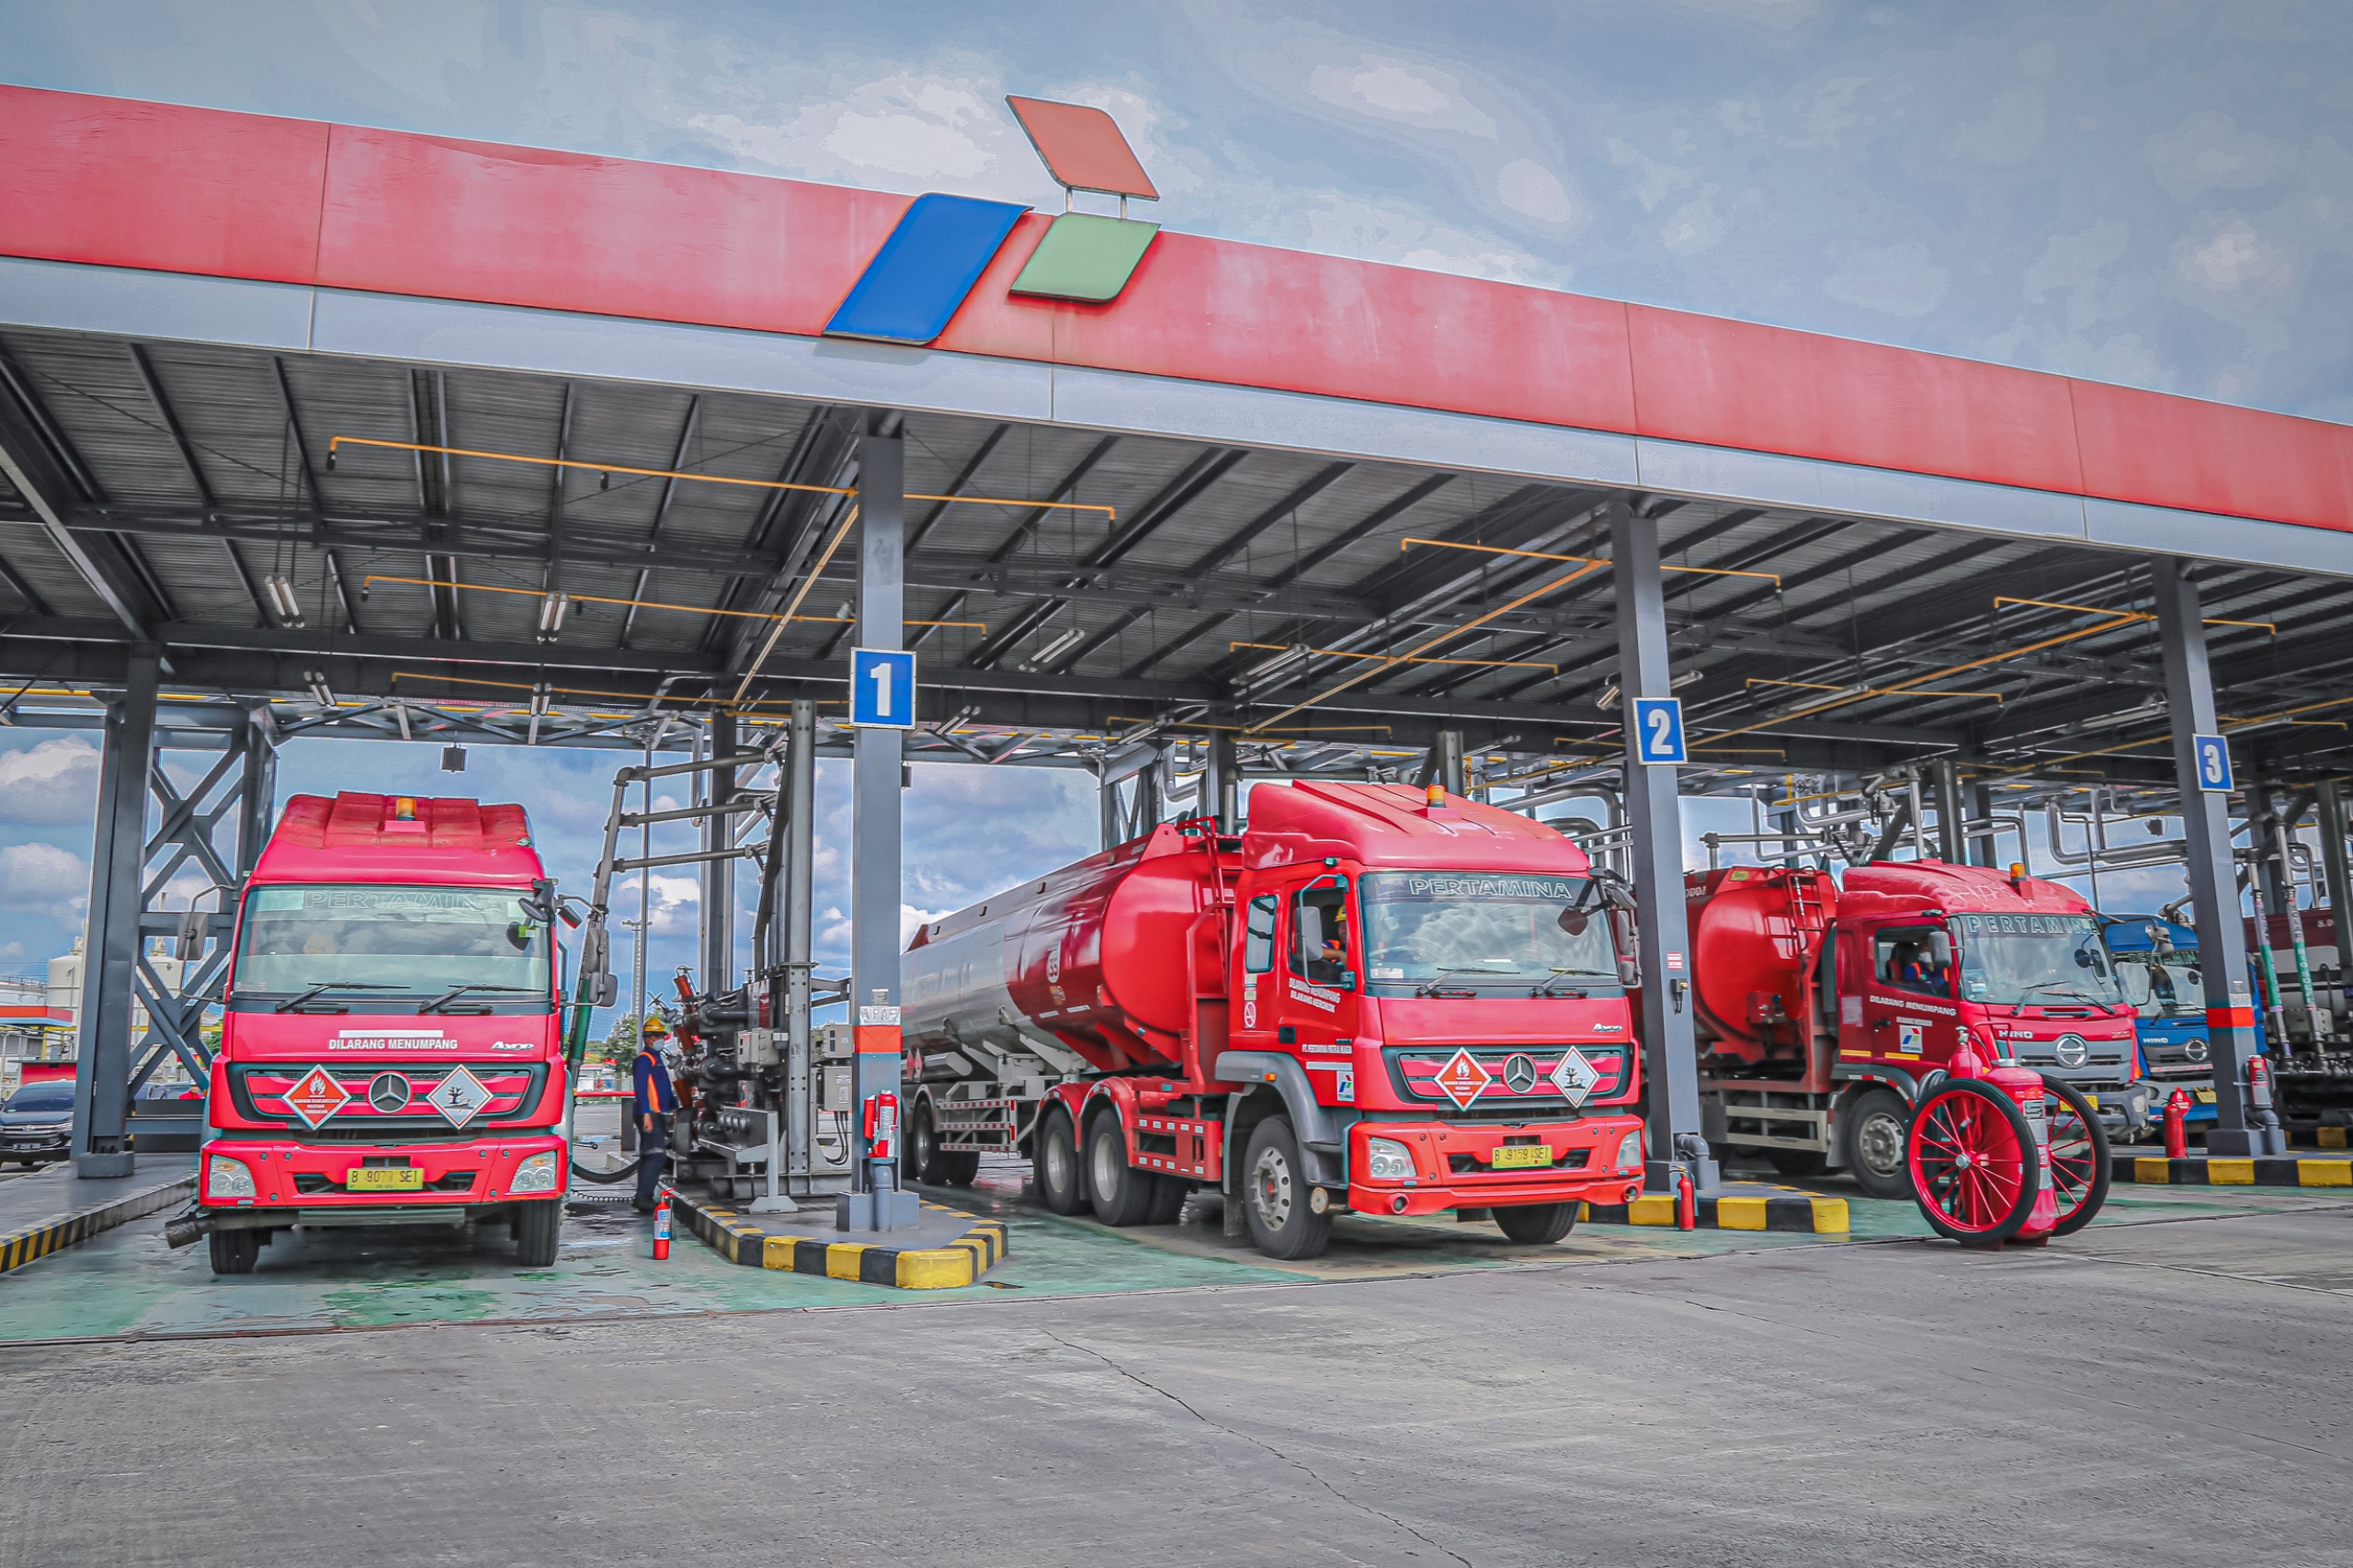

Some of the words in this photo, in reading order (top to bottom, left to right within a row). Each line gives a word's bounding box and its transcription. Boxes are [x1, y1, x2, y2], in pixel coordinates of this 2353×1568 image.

[870, 663, 892, 716] 1
[1647, 709, 1674, 755] 2
[2203, 744, 2222, 783] 3
[1408, 879, 1573, 899] PERTAMINA
[1967, 915, 2101, 936] PERTAMINA
[1870, 995, 1904, 1008] DILARANG
[1905, 1002, 1957, 1017] MENUMPANG
[329, 1040, 386, 1050] DILARANG
[388, 1040, 459, 1050] MENUMPANG
[1998, 1030, 2034, 1039] HINO
[351, 1170, 358, 1183] B
[399, 1170, 417, 1183] SEI
